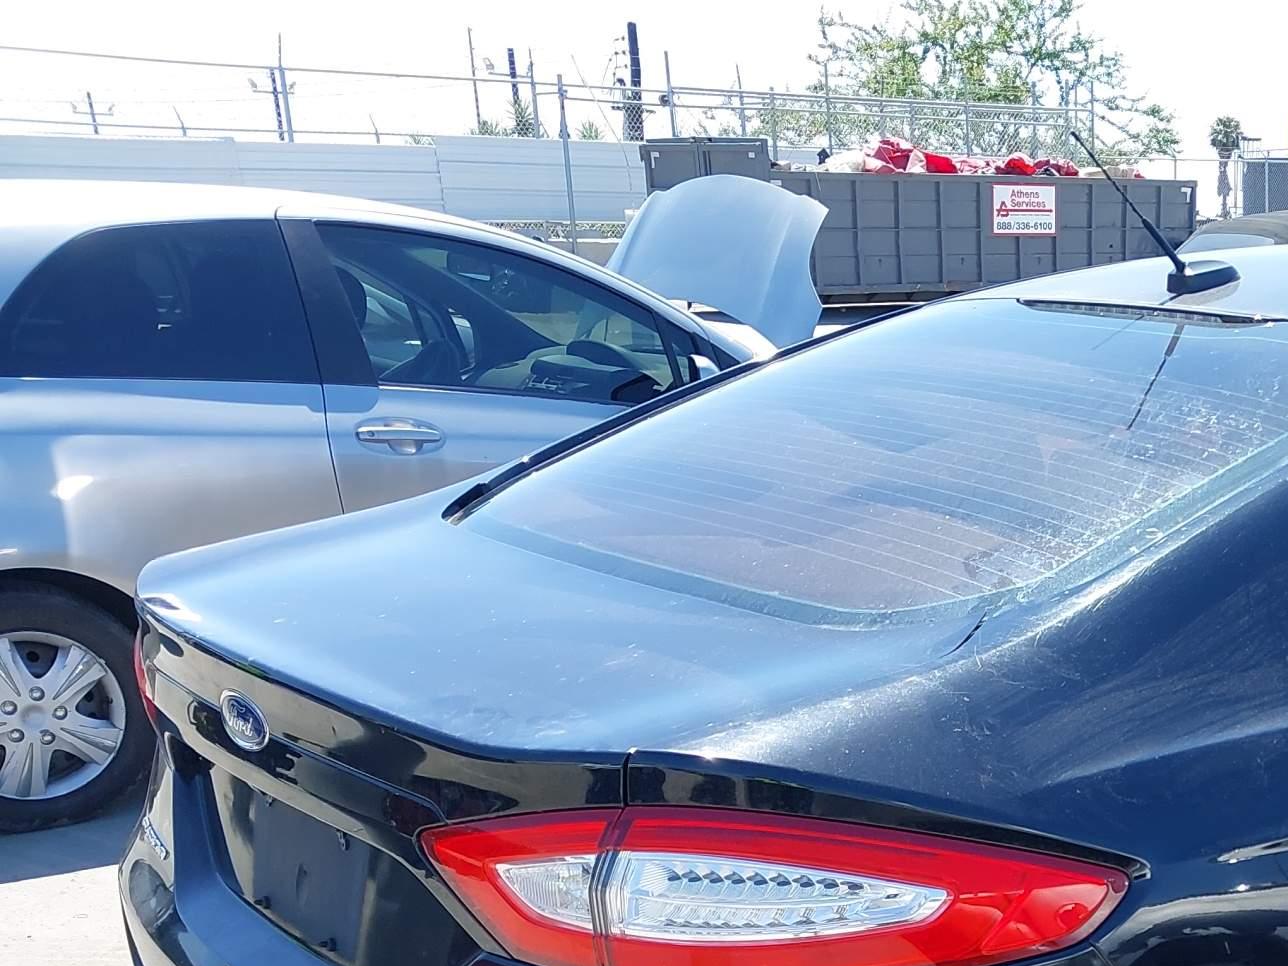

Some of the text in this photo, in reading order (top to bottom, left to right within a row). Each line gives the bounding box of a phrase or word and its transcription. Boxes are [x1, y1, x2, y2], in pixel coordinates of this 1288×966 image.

[1010, 189, 1040, 199] Athens
[1010, 199, 1046, 208] Services
[996, 221, 1053, 231] 888/336-6100
[228, 699, 254, 737] Ford
